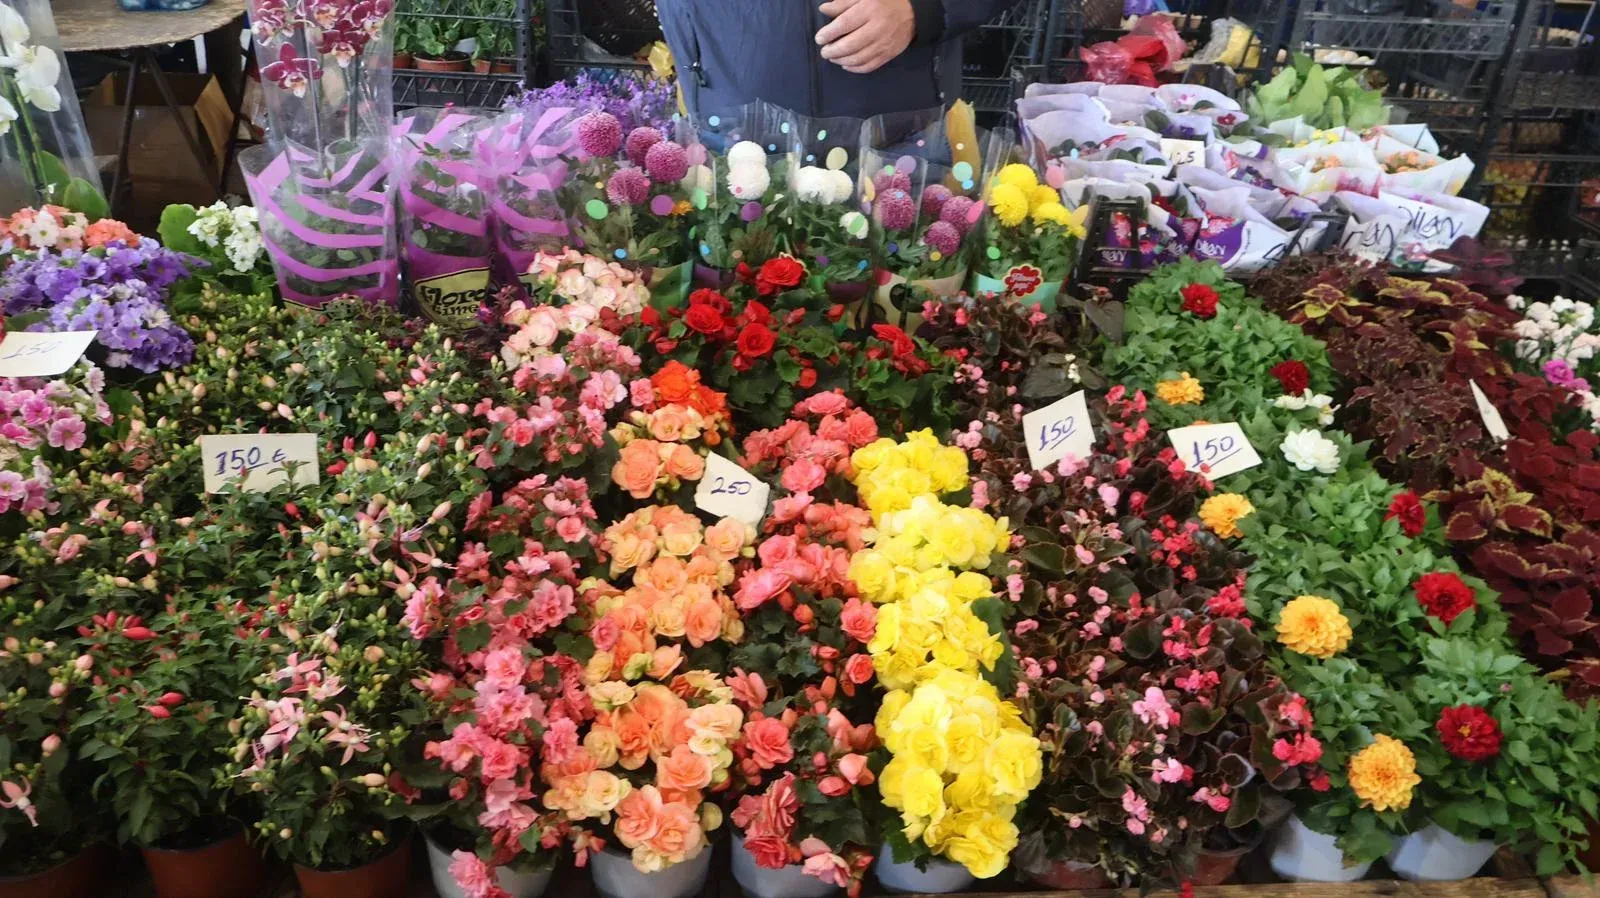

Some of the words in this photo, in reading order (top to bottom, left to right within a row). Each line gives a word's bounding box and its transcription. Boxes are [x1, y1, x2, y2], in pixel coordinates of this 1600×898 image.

[1038, 415, 1074, 451] 150
[214, 446, 261, 476] 150
[1191, 435, 1234, 468] 150
[710, 476, 752, 496] 250
